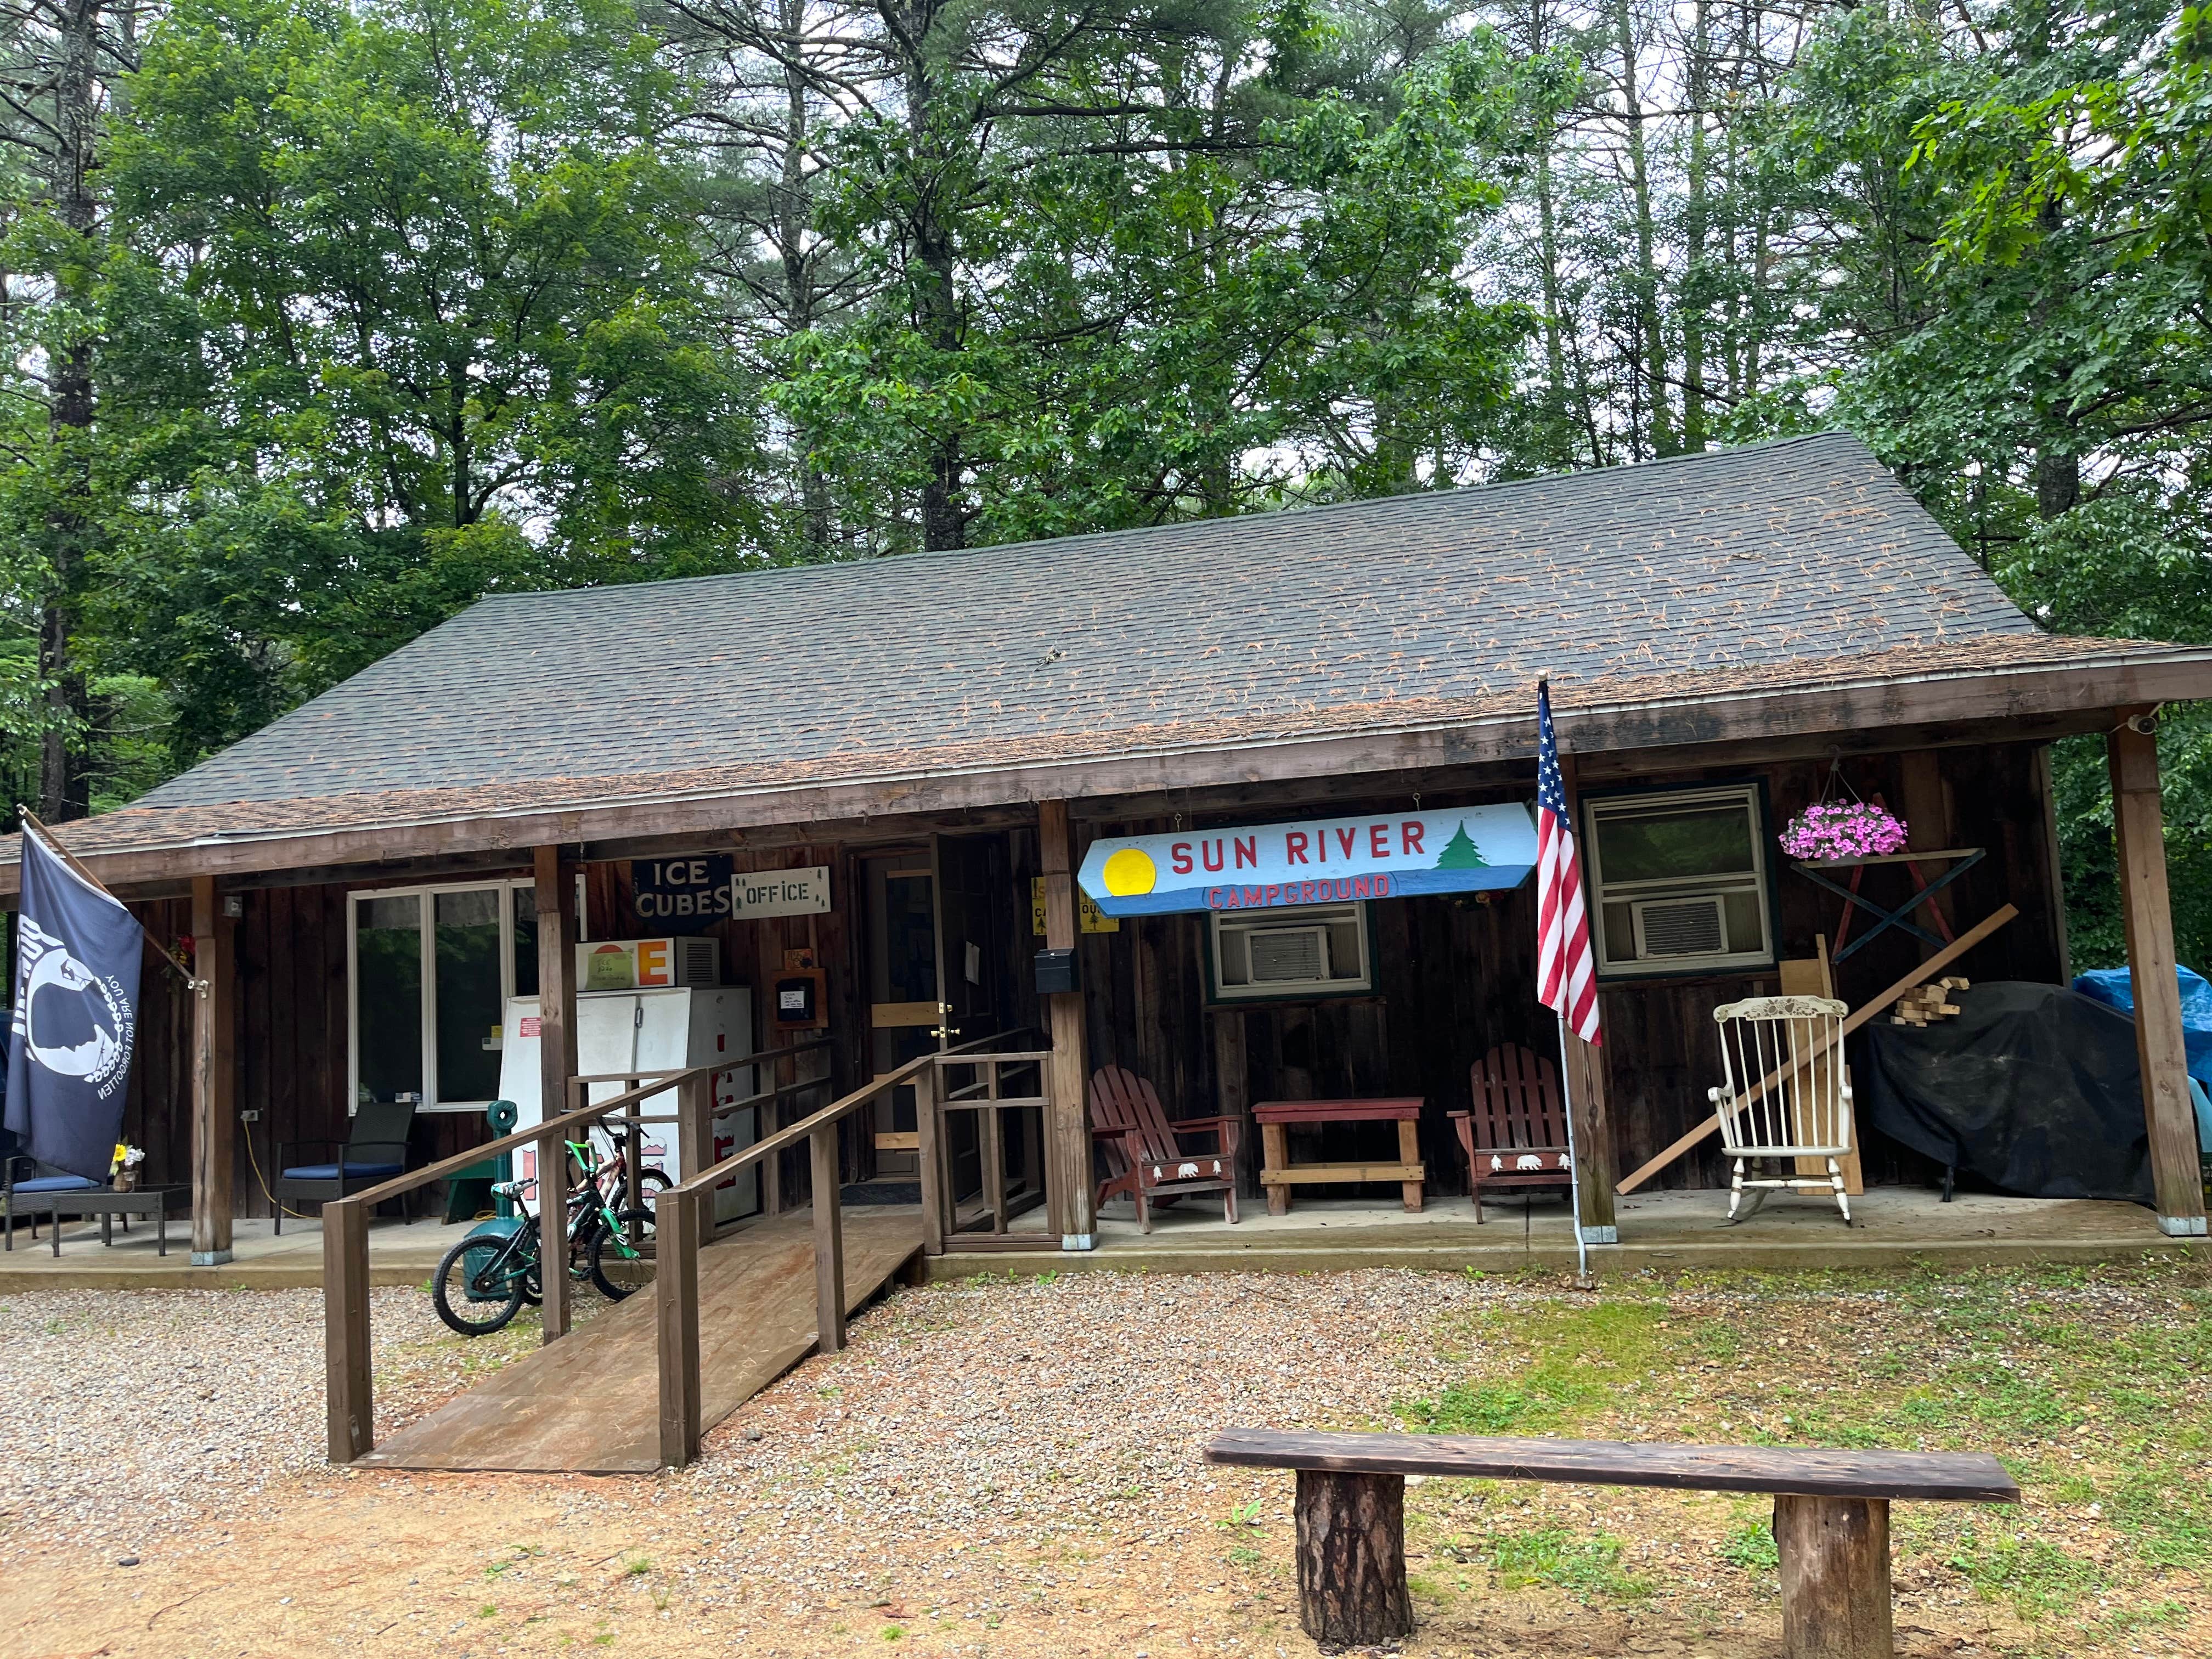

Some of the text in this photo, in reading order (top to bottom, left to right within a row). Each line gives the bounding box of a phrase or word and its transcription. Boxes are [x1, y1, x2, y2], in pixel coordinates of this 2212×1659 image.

[1171, 820, 1425, 874] SUN RIVER
[653, 860, 711, 886] ICE
[635, 885, 730, 917] CUBES
[1209, 874, 1389, 909] CAMPGROUND
